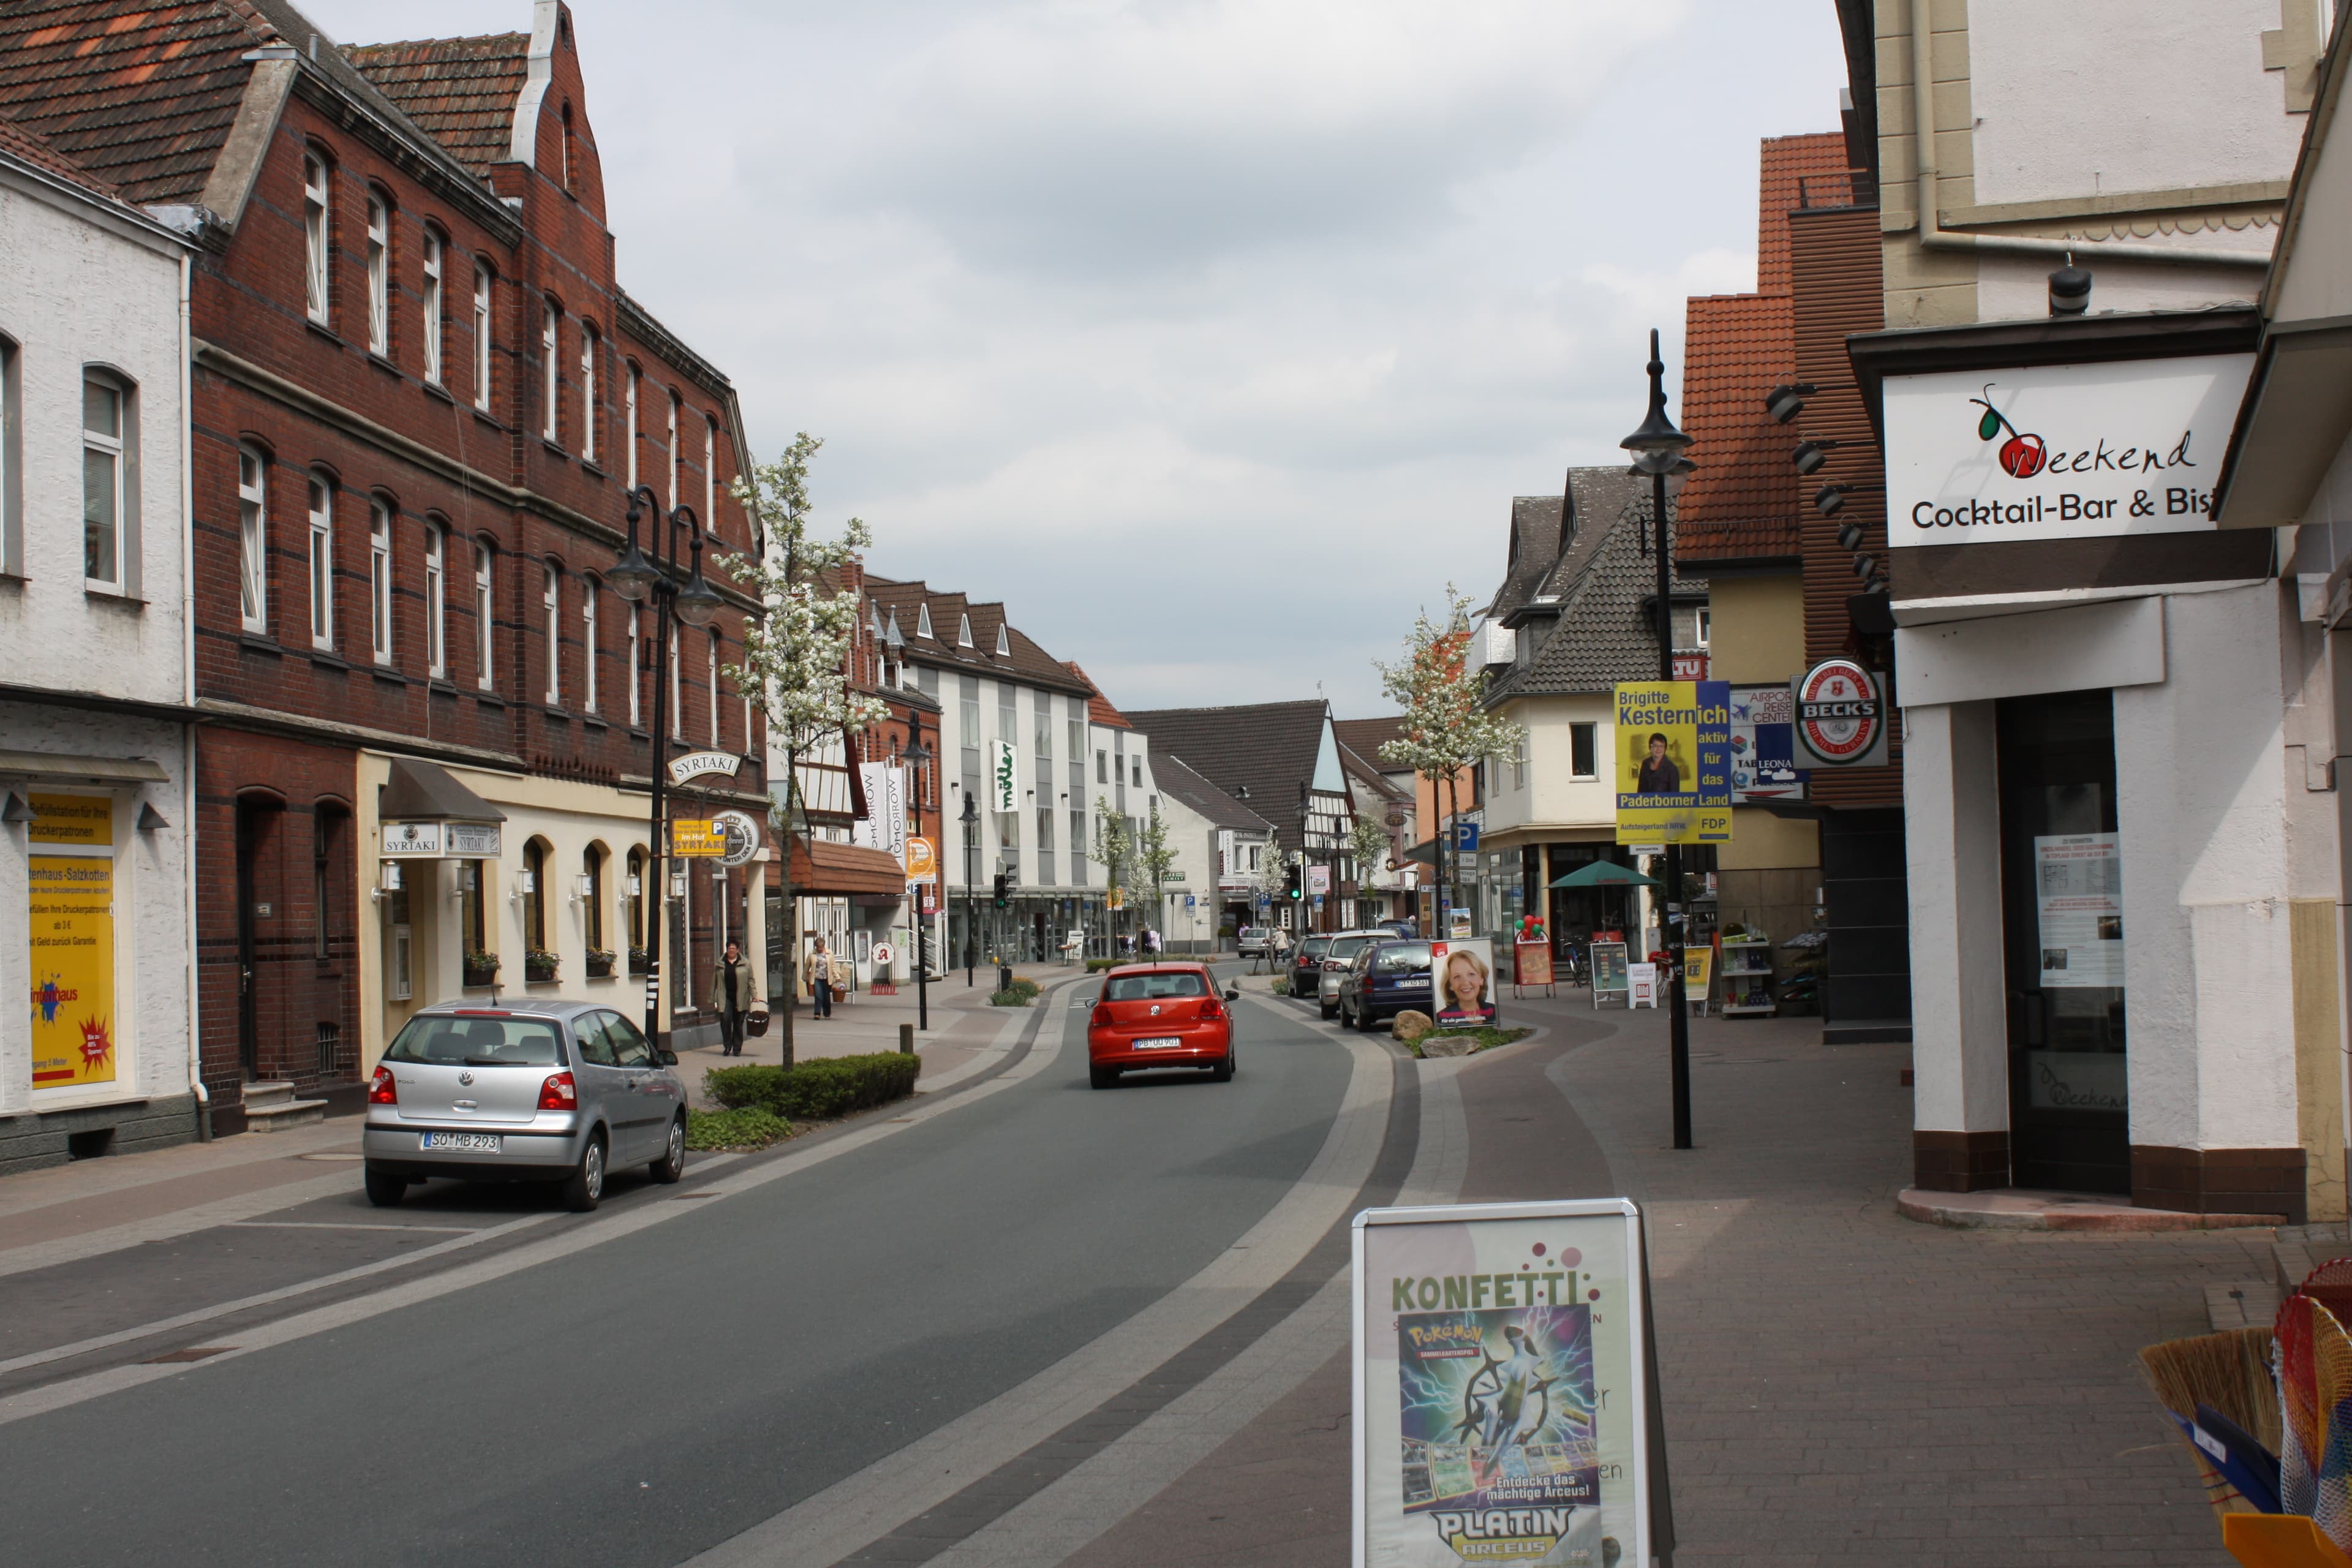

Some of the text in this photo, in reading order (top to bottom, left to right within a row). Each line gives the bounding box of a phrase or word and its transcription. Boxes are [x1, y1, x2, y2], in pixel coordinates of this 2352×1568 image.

[2011, 431, 2196, 477] Weekend
[1912, 492, 2117, 528] Cocktail-Bar
[2129, 490, 2155, 518] &
[1807, 667, 1837, 700] BRAUEREI
[1619, 692, 1670, 707] Brigitte
[1619, 704, 1727, 725] Kesternich
[1803, 701, 1875, 718] BECK'S
[1698, 732, 1727, 744] aktiv
[1704, 753, 1721, 764] für
[1758, 760, 1792, 769] LEONA
[676, 756, 734, 777] SYRTAKI
[997, 743, 1012, 810] möller
[1702, 774, 1724, 785] das
[1620, 794, 1728, 807] Paderborner Land
[30, 803, 108, 819] Befüllstation für Ihre
[713, 822, 723, 834] P
[1620, 823, 1668, 832] Aufsteigerland
[1701, 818, 1726, 829] FDP
[29, 823, 94, 839] Druckerpatronen
[742, 824, 753, 845] BIEREN
[1457, 827, 1472, 848] P
[387, 842, 435, 850] SYRTAKI
[460, 838, 484, 851] SYRTAKI
[741, 846, 751, 858] DEN
[63, 905, 109, 915] Druckerpatronen
[37, 937, 50, 946] Geld
[72, 936, 96, 945] Garantie
[1637, 985, 1649, 997] Bild
[432, 1134, 497, 1148] SO MB 293
[1392, 1270, 1577, 1311] KONFETTI
[1496, 1475, 1575, 1488] Entdecke das
[1487, 1485, 1589, 1500] mächtige Arceus!
[1434, 1507, 1576, 1544] PLATIN
[1461, 1541, 1547, 1556] ARCEUS
